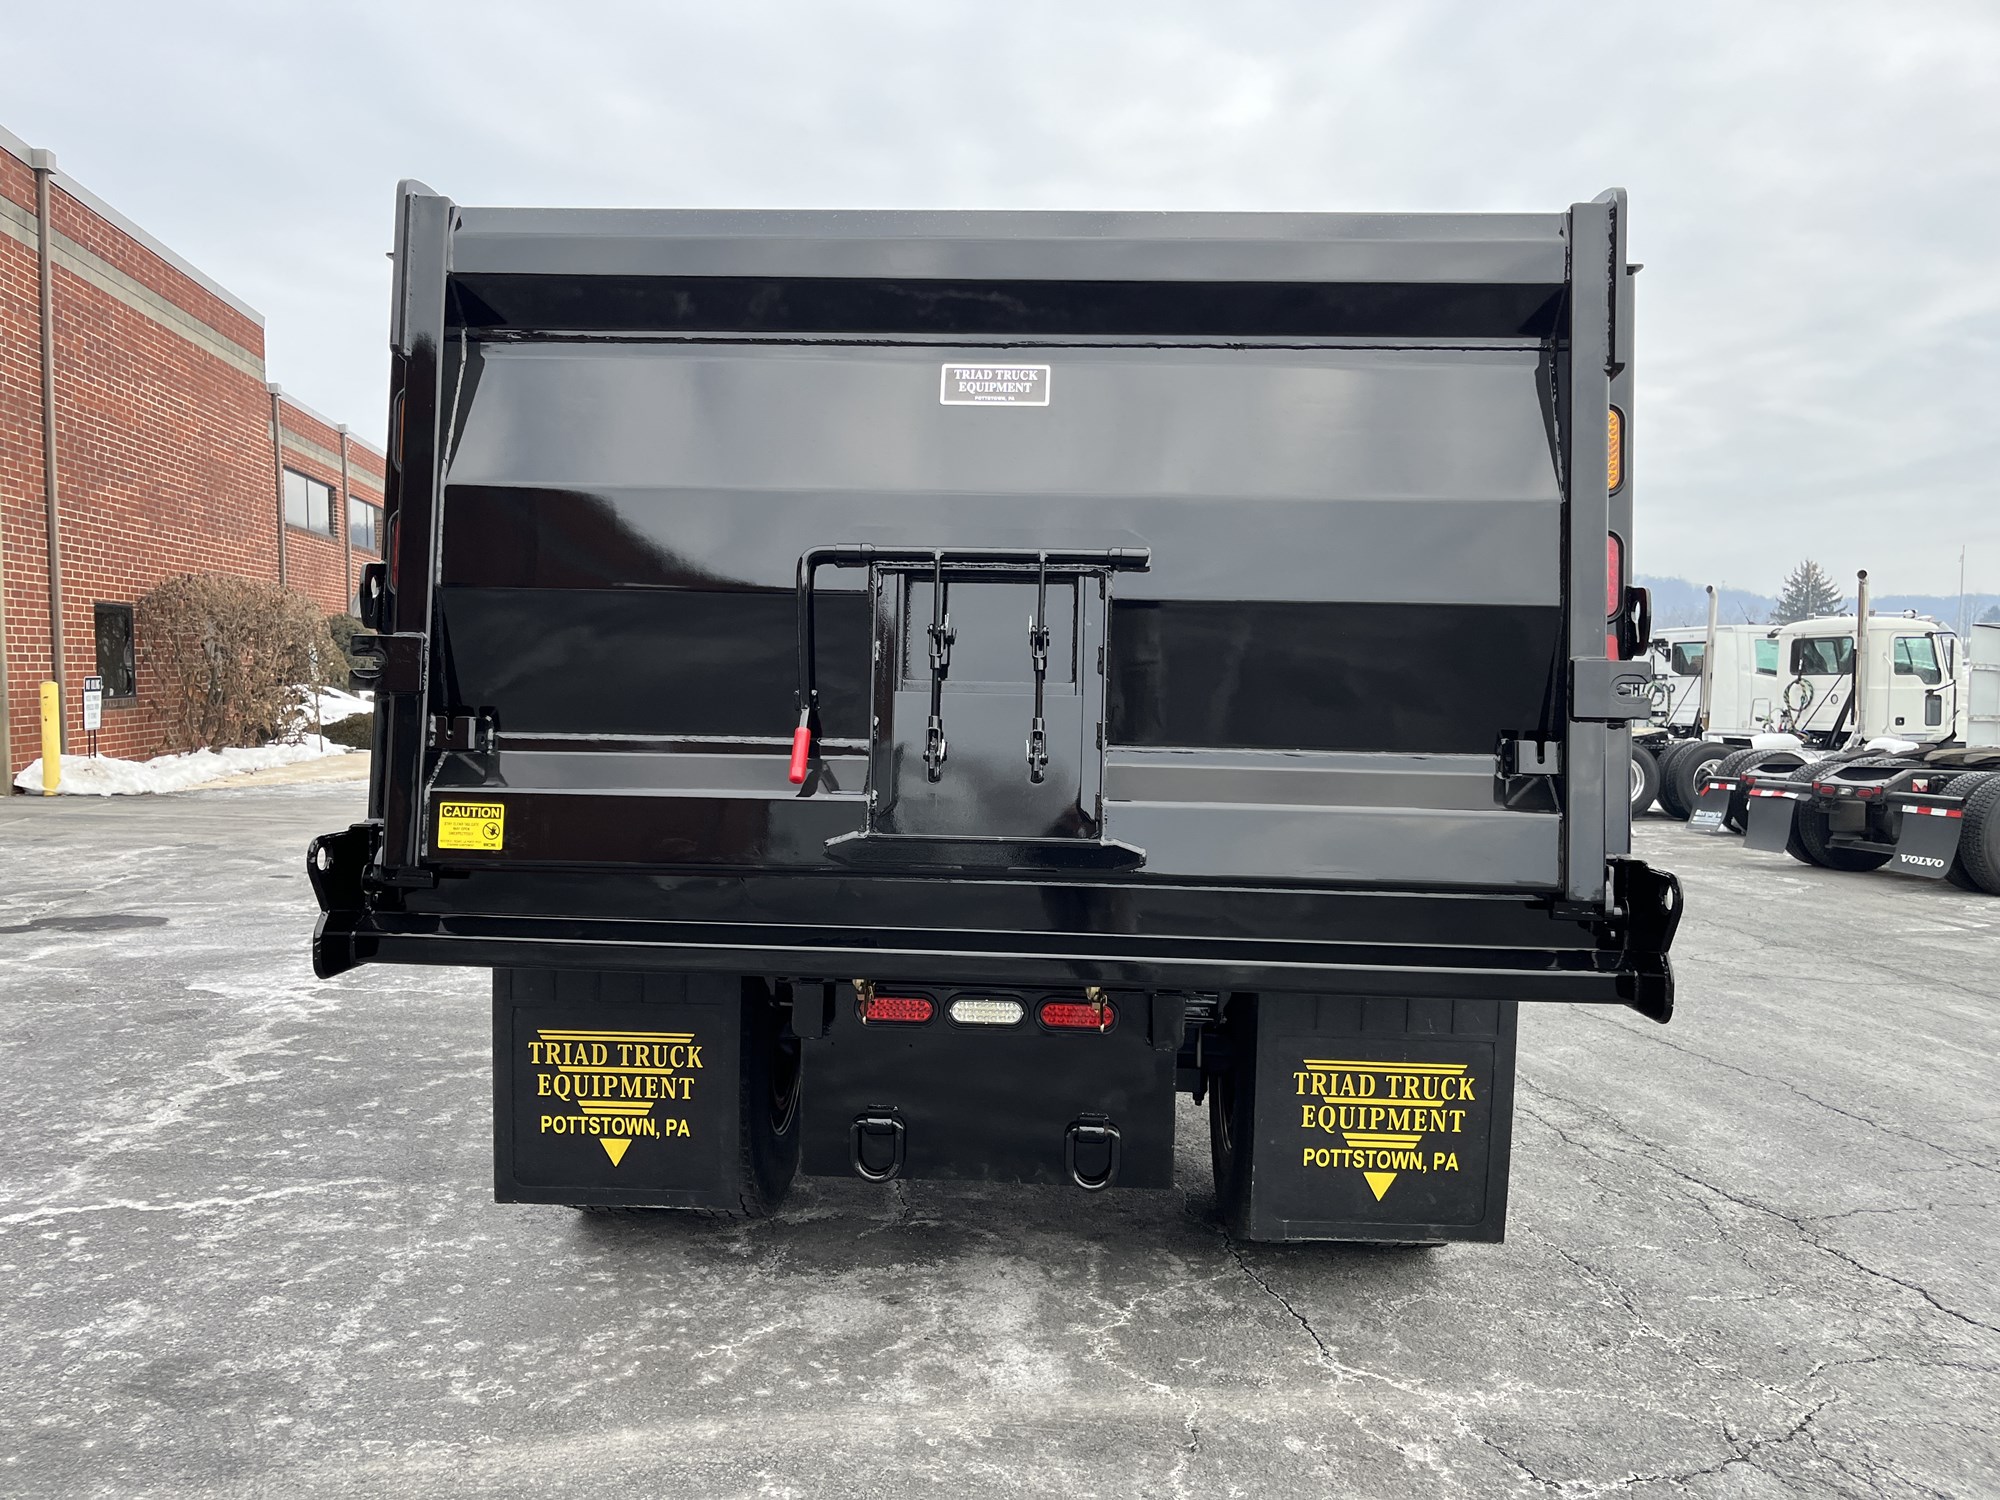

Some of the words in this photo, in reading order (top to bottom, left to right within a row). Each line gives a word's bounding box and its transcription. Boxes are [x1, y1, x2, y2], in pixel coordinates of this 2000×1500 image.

[953, 369, 992, 380] TRIAD
[995, 370, 1038, 381] TRUCK
[958, 381, 1033, 394] EQUIPMENT
[443, 806, 500, 818] CAUTION
[1900, 853, 1945, 868] VOLVO
[528, 1042, 608, 1066] TRIAD
[617, 1044, 703, 1069] TRUCK
[537, 1073, 695, 1102] EQUIPMENT
[1293, 1072, 1376, 1097] TRIAD
[1386, 1075, 1476, 1101] TRUCK
[540, 1115, 661, 1140] POTTSTOWN,
[666, 1118, 691, 1138] PA
[1301, 1104, 1466, 1134] EQUIPMENT
[1303, 1147, 1427, 1174] POTTSTOWN,
[1433, 1152, 1459, 1172] PA
